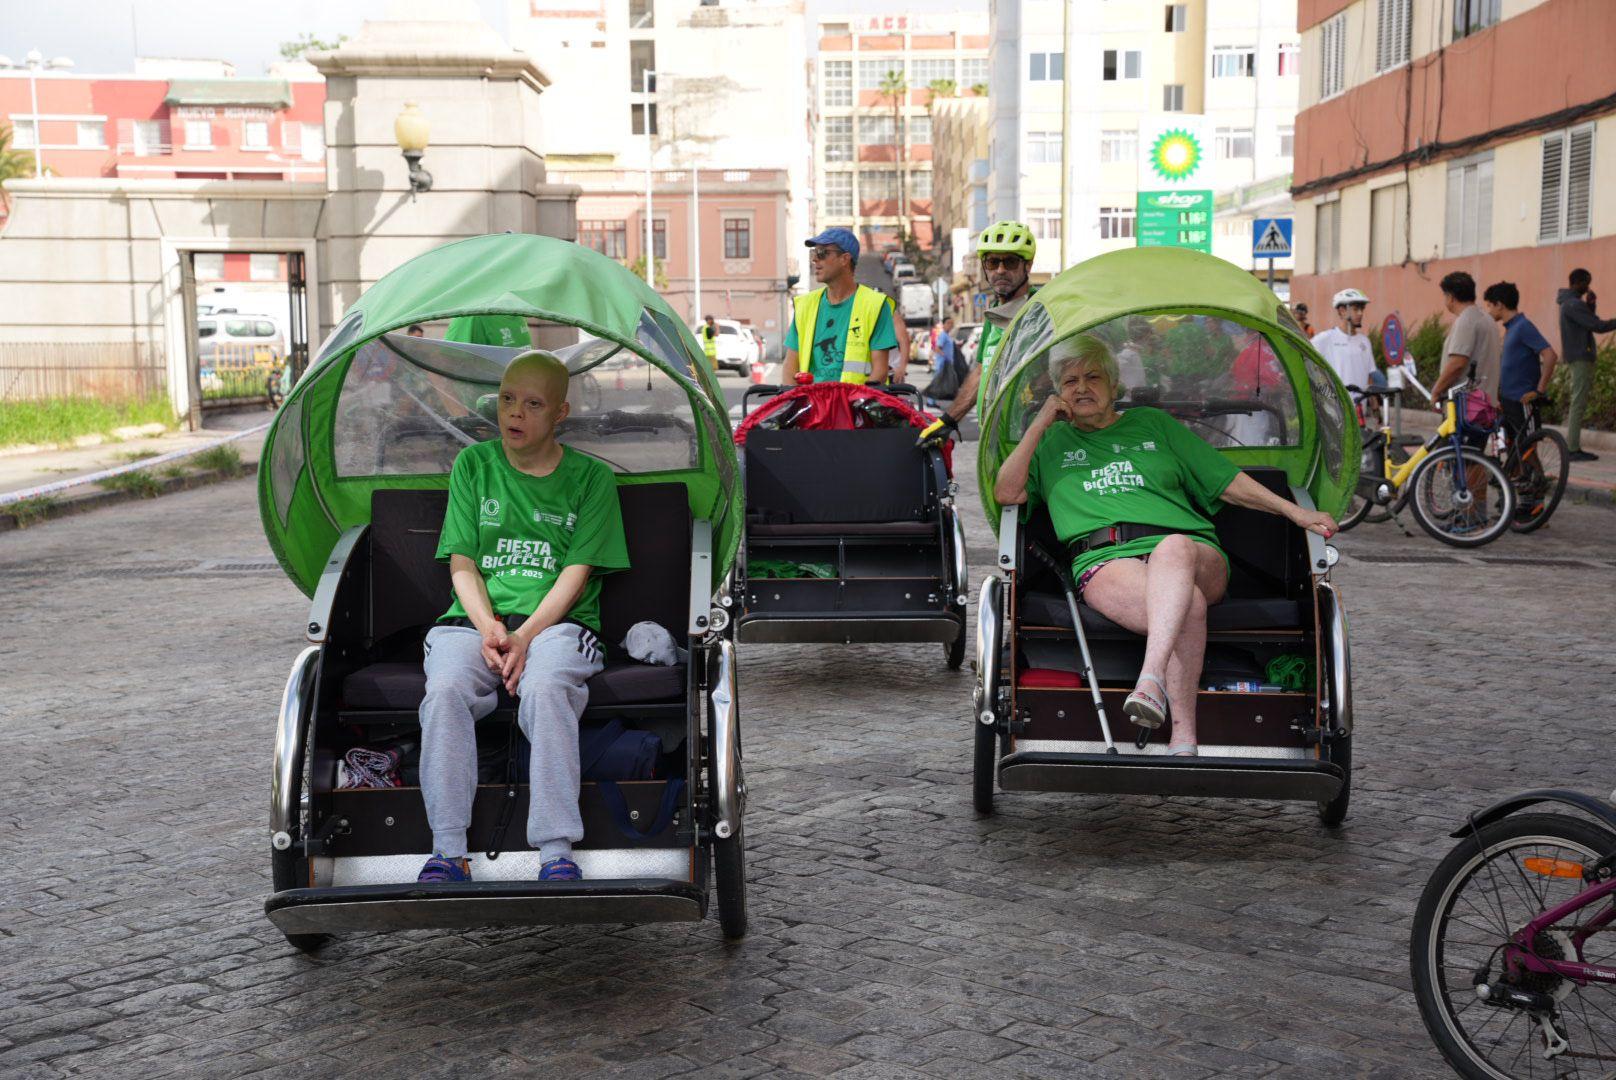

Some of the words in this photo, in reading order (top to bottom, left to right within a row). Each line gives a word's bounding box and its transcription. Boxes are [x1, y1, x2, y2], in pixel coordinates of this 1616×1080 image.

[1158, 192, 1204, 207] shop
[1091, 460, 1133, 478] FIESTA
[1083, 474, 1145, 492] BICICLETA
[497, 539, 551, 556] FIESTA
[482, 556, 557, 572] BICICLETA
